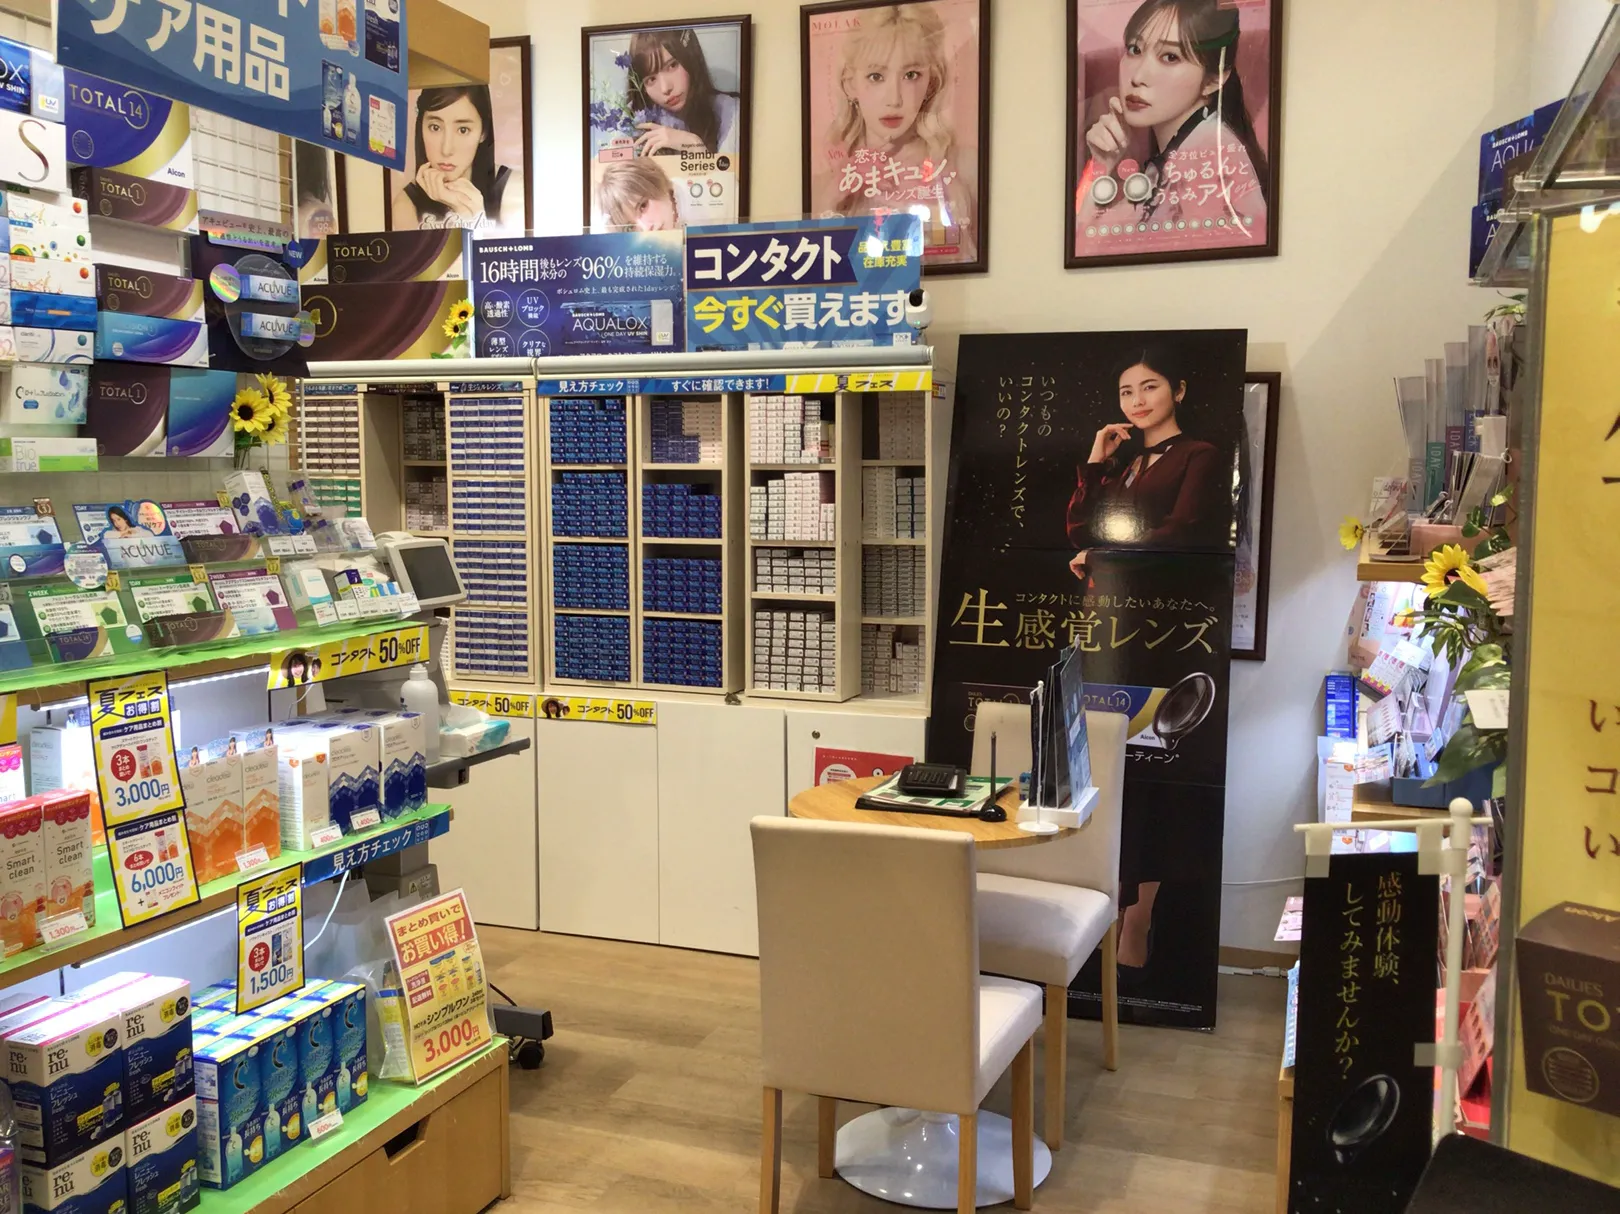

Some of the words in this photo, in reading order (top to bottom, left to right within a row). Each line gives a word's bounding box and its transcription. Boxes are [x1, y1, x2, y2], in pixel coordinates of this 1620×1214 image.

[90, 0, 290, 101] ケア用品
[6, 83, 26, 94] SHIN
[69, 84, 127, 114] TOTAL
[129, 101, 143, 119] 14
[18, 119, 50, 183] S
[854, 148, 888, 164] 恋する
[167, 167, 186, 179] Alcon
[680, 161, 716, 172] Series
[1165, 157, 1250, 183] ちゅるんと
[839, 157, 948, 198] あまキュン
[100, 181, 133, 198] TOTAL
[885, 184, 945, 201] レンズ誕生
[1156, 180, 1236, 206] うるみアイ
[288, 250, 303, 259] NEW
[333, 246, 373, 258] TOTAL
[478, 244, 534, 253] BAUSCH+LOMB
[539, 256, 583, 269] 後もレンズ
[625, 253, 667, 265] を維持する
[694, 235, 842, 282] コンタクト
[480, 257, 539, 284] 16時間
[540, 268, 568, 280] 水分の
[581, 255, 624, 280] 96%
[107, 276, 140, 291] TOTAL
[257, 280, 292, 298] ACUVUE
[484, 300, 511, 310] 高い酸素
[521, 304, 545, 313] ブロック
[526, 296, 539, 305] UV
[486, 309, 509, 318] 透過性
[693, 289, 909, 334] 今すぐ買えます
[259, 318, 293, 335] ACUVUE
[572, 316, 648, 332] AQUALOX
[489, 345, 509, 353] レンズ
[490, 337, 506, 346] 薄型
[522, 340, 547, 349] クリアな
[526, 348, 542, 357] 視界
[99, 386, 134, 399] TOTAL
[558, 380, 624, 393] 見え方チェック
[671, 378, 770, 392] すぐに確認できます!
[996, 376, 1014, 438] いいの?
[1037, 375, 1056, 436] いつもの
[15, 444, 37, 461] Bio
[1010, 375, 1034, 528] コンタクトレンズで、
[15, 460, 37, 472] true
[120, 543, 173, 560] ACUVUE
[27, 589, 49, 597] 2WEEK
[1015, 592, 1216, 612] コンタクトに感動したいあなたへ。
[949, 587, 1219, 654] 生感覚レンズ
[331, 648, 376, 667] コンタクト
[379, 636, 421, 663] 50%OFF
[93, 685, 163, 722] 夏フェス
[125, 699, 161, 718] お得割
[457, 697, 493, 708] コンタクト
[494, 697, 530, 713] 50%OFF
[577, 704, 615, 714] コンタクト
[617, 703, 655, 720] 50%OFF
[1139, 733, 1156, 742] Alcon
[115, 754, 130, 766] 3本
[114, 778, 170, 807] 3,000円
[57, 839, 84, 856] Smart
[333, 828, 412, 874] 見え方チェック
[6, 855, 36, 870] Smart
[58, 850, 83, 865] clean
[133, 853, 145, 863] 6本
[8, 865, 35, 880] clean
[131, 862, 184, 893] 6,000円
[242, 878, 298, 914] 夏フェス
[396, 903, 461, 938] まとめ買いで
[1372, 871, 1402, 985] 感動体験、
[401, 919, 466, 964] お買い得!
[253, 946, 266, 958] 3本
[249, 964, 294, 995] 1,500円
[1334, 882, 1365, 1081] してみませんか?
[1544, 972, 1604, 998] DAILIES
[426, 995, 470, 1026] シンプルワン
[1546, 988, 1620, 1032] TO
[126, 1023, 146, 1039] nu
[423, 1018, 480, 1063] 3,000円
[10, 1062, 28, 1075] nu
[48, 1058, 70, 1075] nu
[132, 1140, 152, 1157] nu
[53, 1182, 75, 1199] nu
